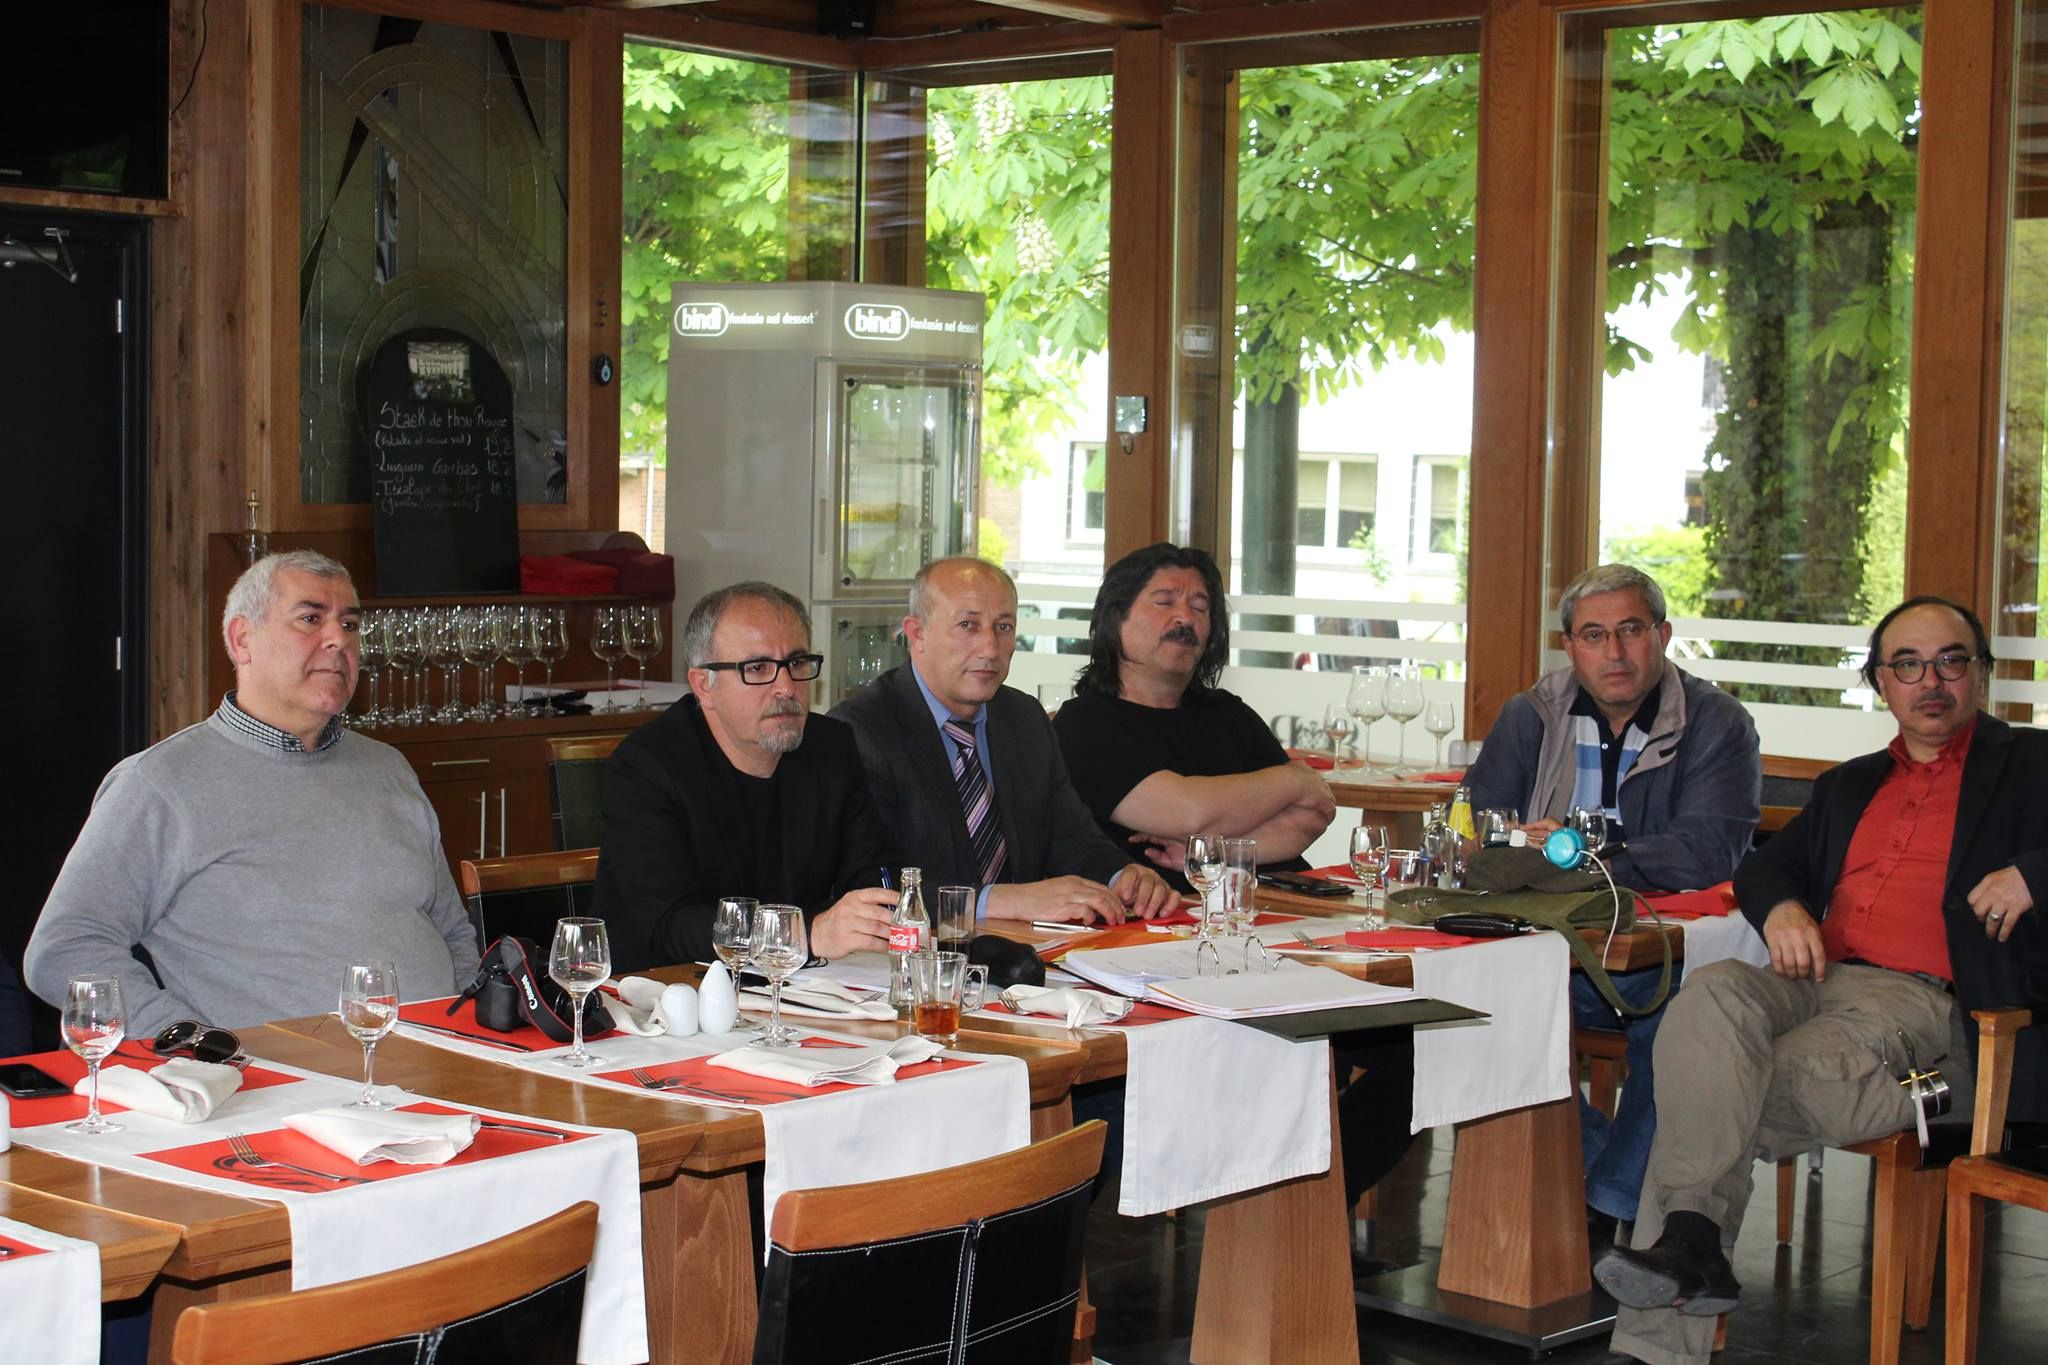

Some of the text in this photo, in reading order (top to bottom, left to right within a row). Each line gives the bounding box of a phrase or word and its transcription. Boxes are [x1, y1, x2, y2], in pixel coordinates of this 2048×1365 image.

[681, 307, 815, 330] bindi fantasia nel dessert
[855, 307, 902, 334] bindi
[910, 317, 943, 331] fantasia
[944, 320, 956, 332] nel
[429, 410, 442, 428] de
[521, 974, 538, 1010] Canon
